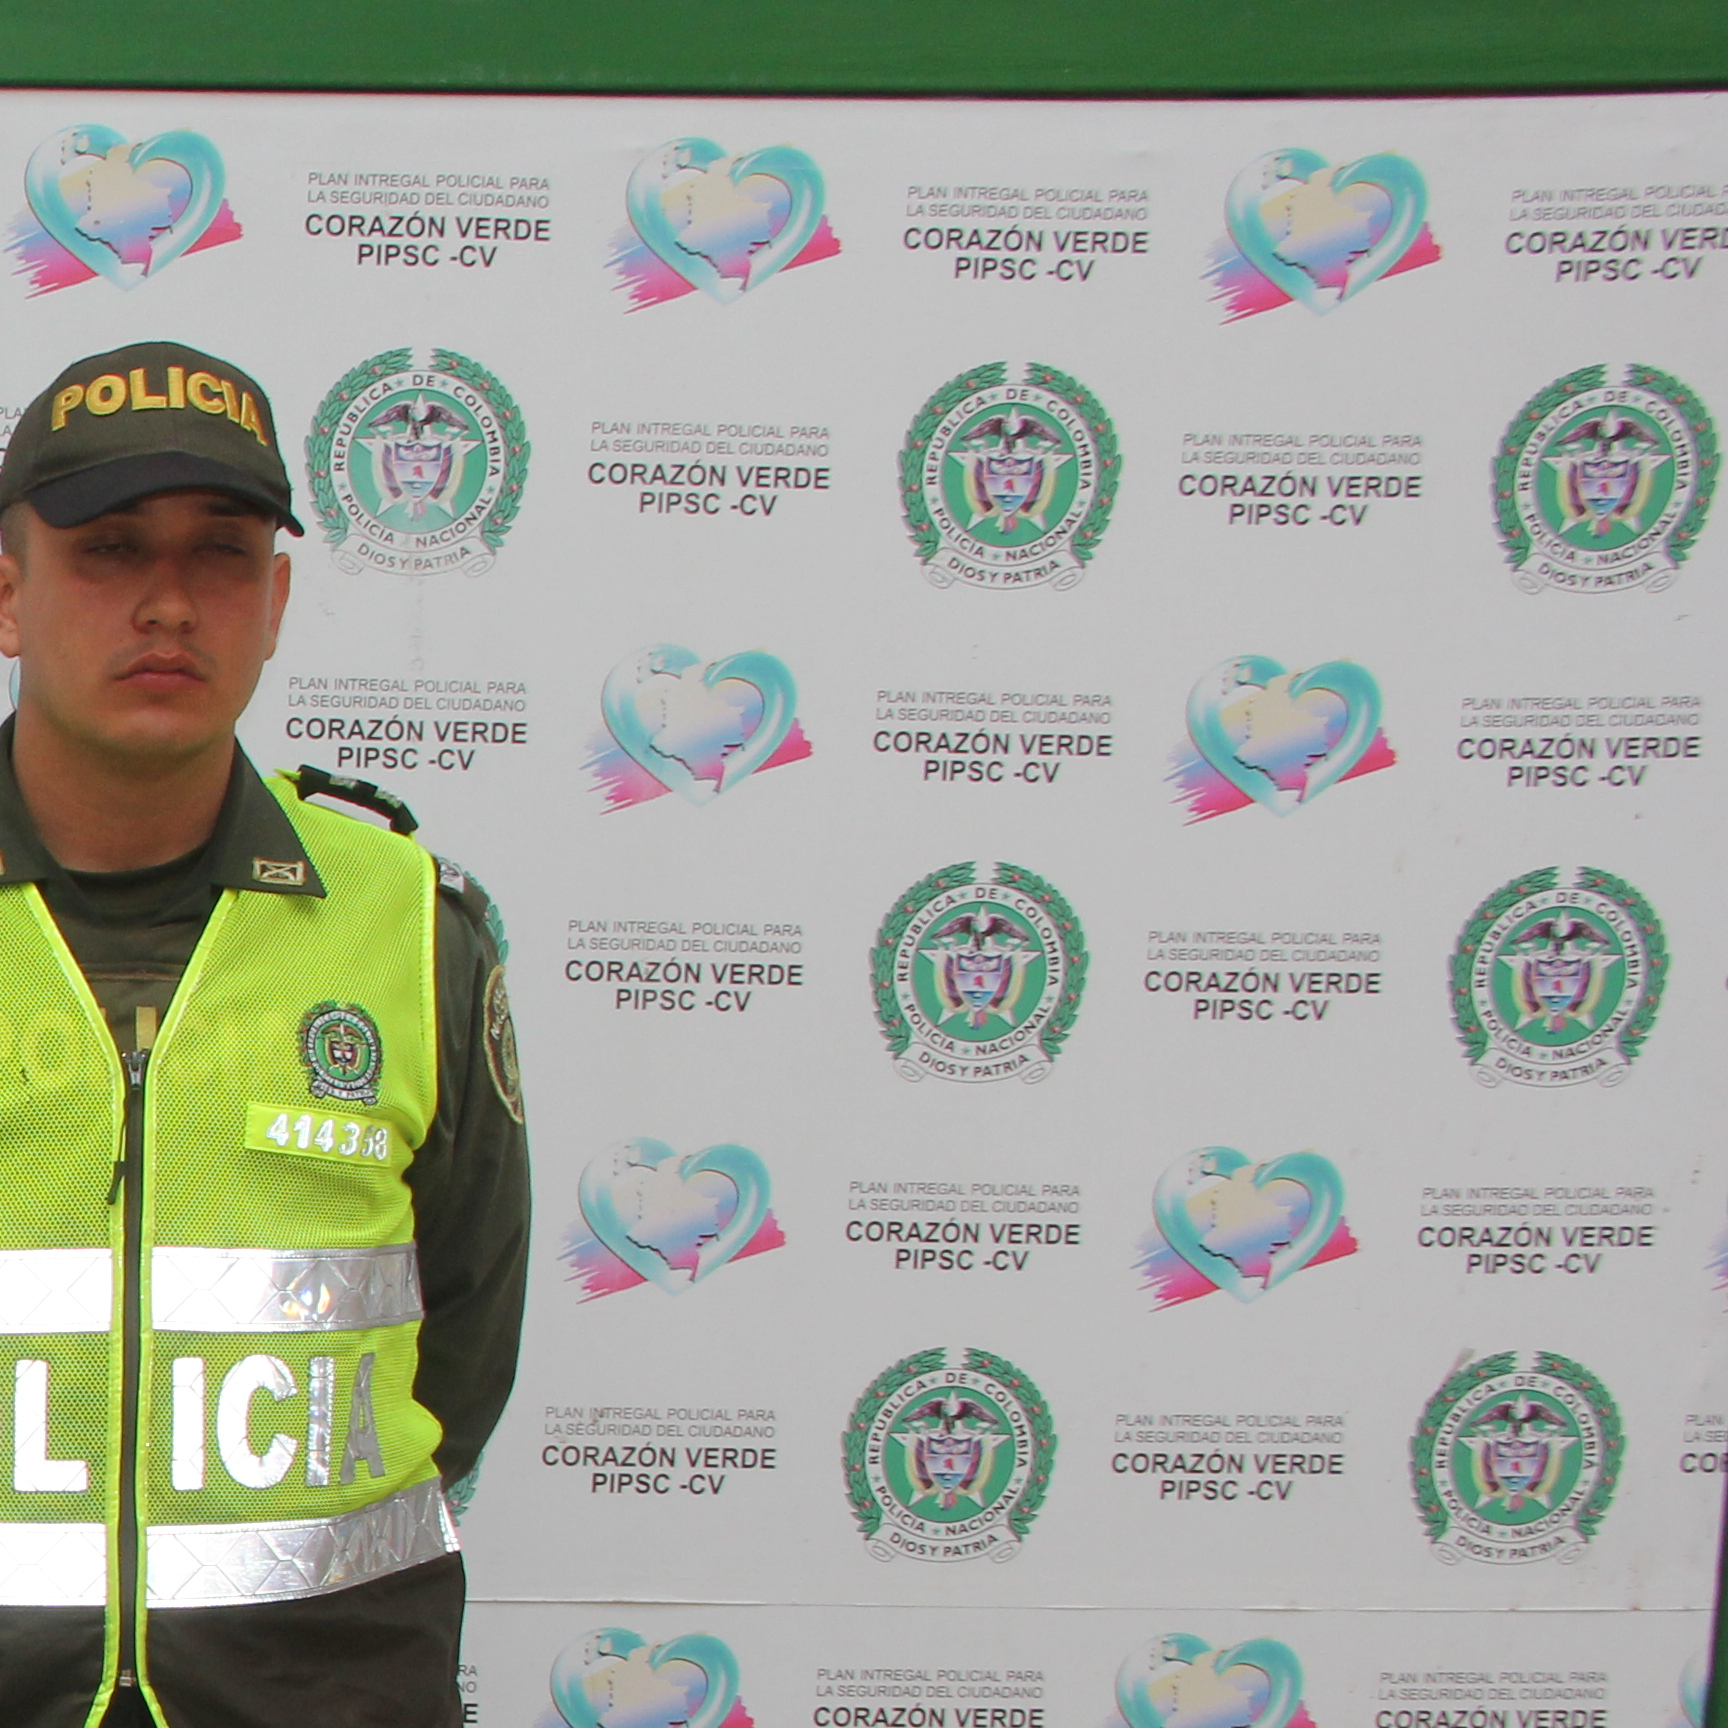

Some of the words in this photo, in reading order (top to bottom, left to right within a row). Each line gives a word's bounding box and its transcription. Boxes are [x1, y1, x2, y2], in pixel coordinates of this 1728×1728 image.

[308, 172, 349, 185] PLAN
[355, 173, 430, 187] INTREGAL
[436, 174, 503, 189] POLICIAL
[510, 177, 550, 190] PARA
[308, 190, 326, 203] LA
[330, 190, 420, 205] SEGURIDAD
[425, 192, 454, 205] DEL
[458, 192, 549, 209] CIUDADANO
[305, 210, 446, 238] CORAZÓN
[455, 216, 551, 242] VERDE
[357, 243, 440, 267] PIPSC
[51, 365, 269, 447] POLICIA
[1144, 967, 1281, 993] CORAZÓN
[1288, 972, 1384, 994] VERDE
[1193, 999, 1275, 1021] PIPSC
[1111, 1449, 1245, 1474] CORAZÓN
[1253, 1454, 1346, 1475] VERDE
[1160, 1480, 1239, 1501] PIPSC
[817, 1668, 855, 1680] PLAN
[861, 1669, 932, 1681] INTREGAL
[937, 1670, 1001, 1682] POLICIAL
[1006, 1670, 1044, 1682] PARA
[816, 1686, 834, 1697] LA
[837, 1685, 922, 1697] SEGURIDAD
[926, 1686, 953, 1698] DEL
[957, 1686, 1043, 1698] CIUDADANO
[813, 1703, 947, 1728] CORAZÓN
[954, 1708, 1045, 1728] VERDE
